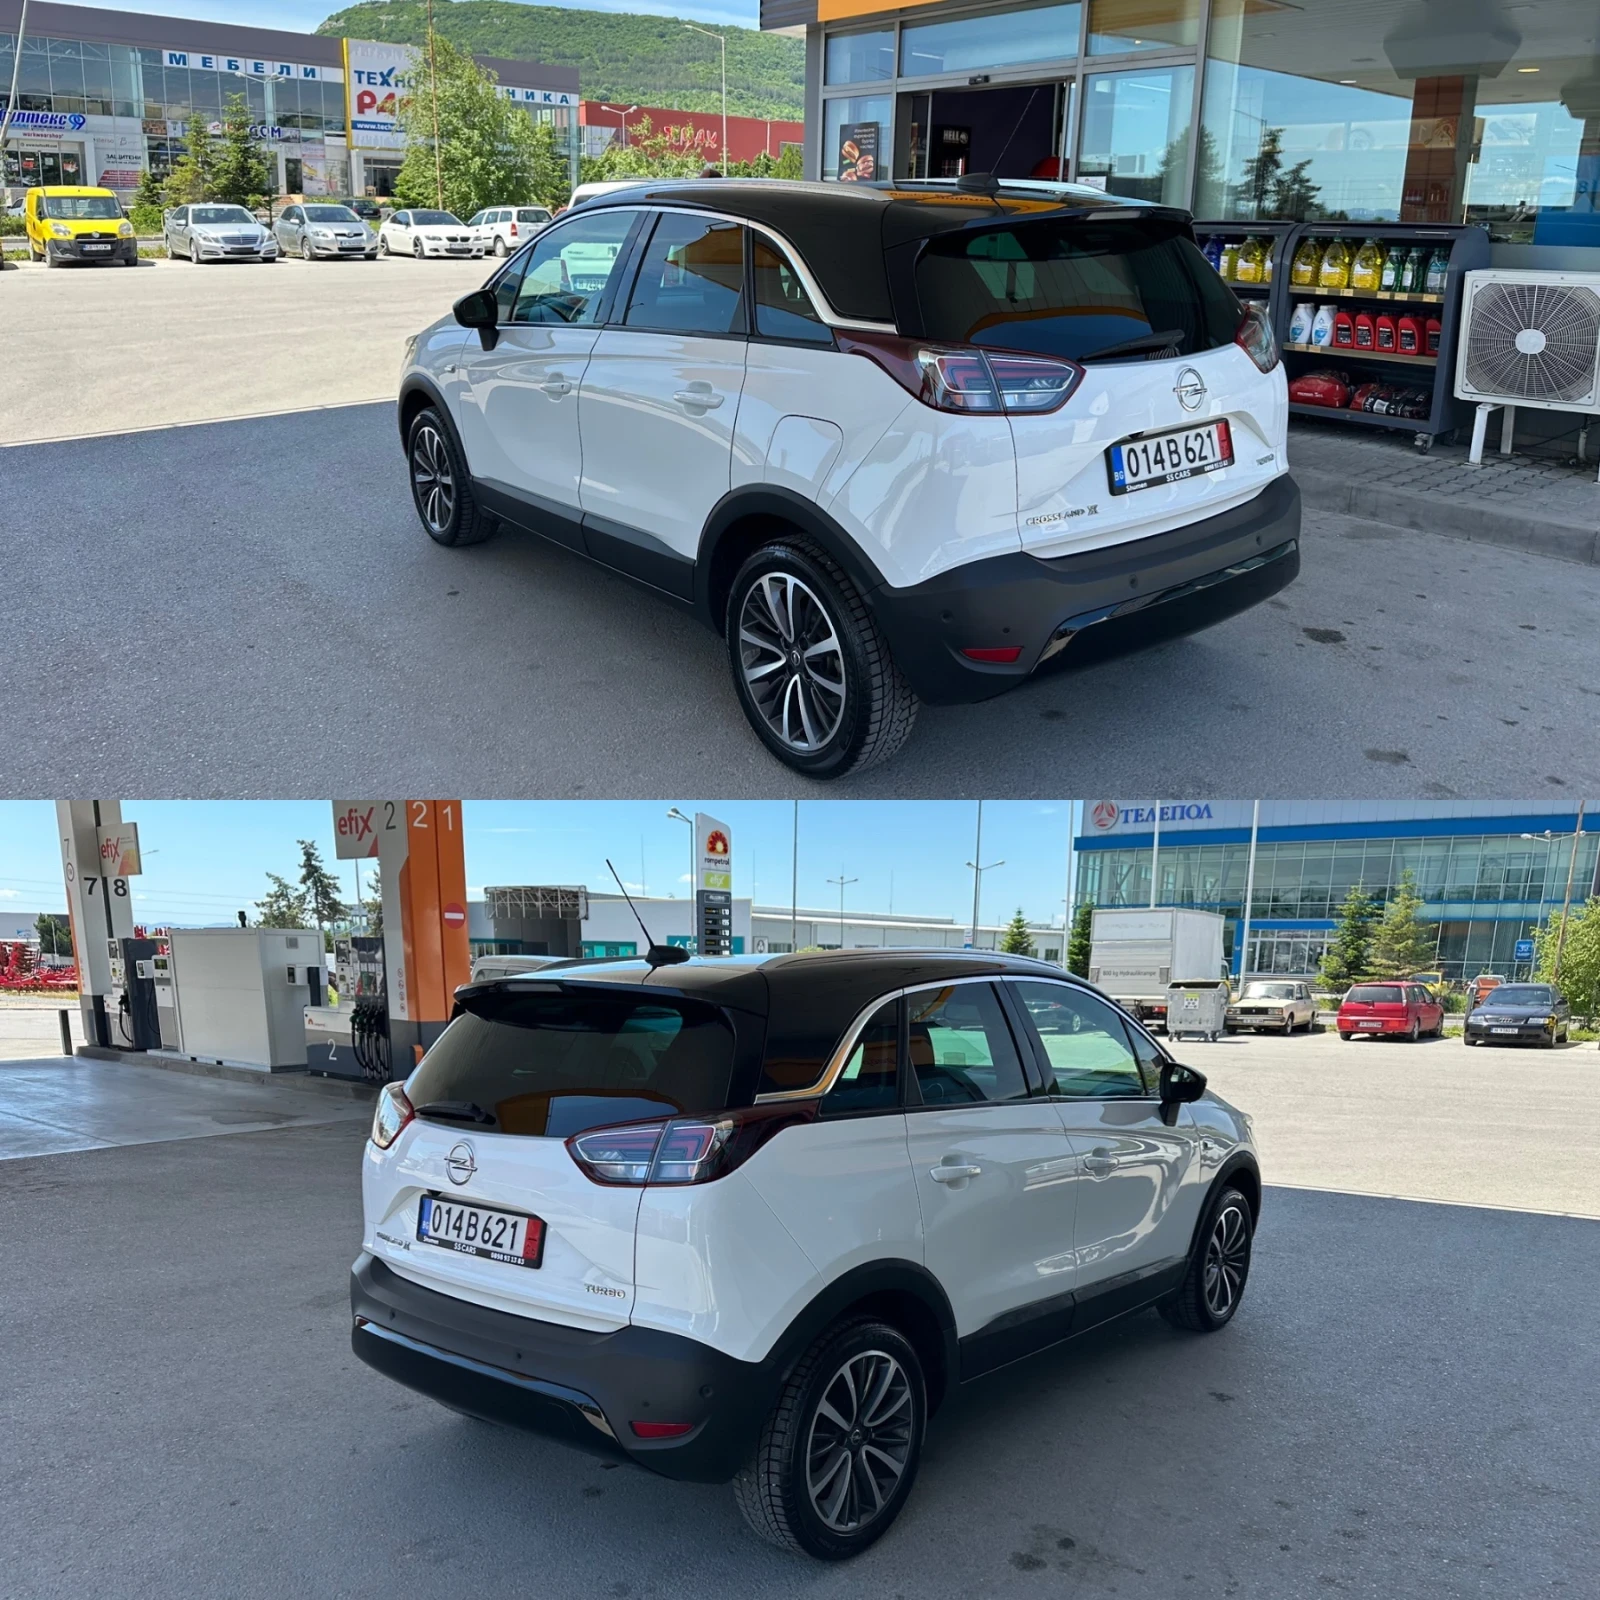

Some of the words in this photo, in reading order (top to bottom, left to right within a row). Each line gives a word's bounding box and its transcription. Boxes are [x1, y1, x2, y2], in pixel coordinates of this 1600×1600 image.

[168, 52, 316, 79] МЕБЕЛИ
[1126, 429, 1216, 478] 014B621
[1113, 470, 1125, 481] BG
[1176, 469, 1191, 480] CARS
[337, 806, 375, 842] efix
[384, 800, 397, 831] 2
[412, 801, 429, 829] 2
[442, 804, 453, 832] 1
[1120, 802, 1214, 825] ТЕЛЕПОЛ
[100, 836, 121, 864] efix
[83, 876, 98, 896] 7
[113, 878, 128, 898] 8
[327, 1038, 338, 1061] 2
[432, 1204, 518, 1251] 014B621
[584, 1283, 626, 1299] TURBO
